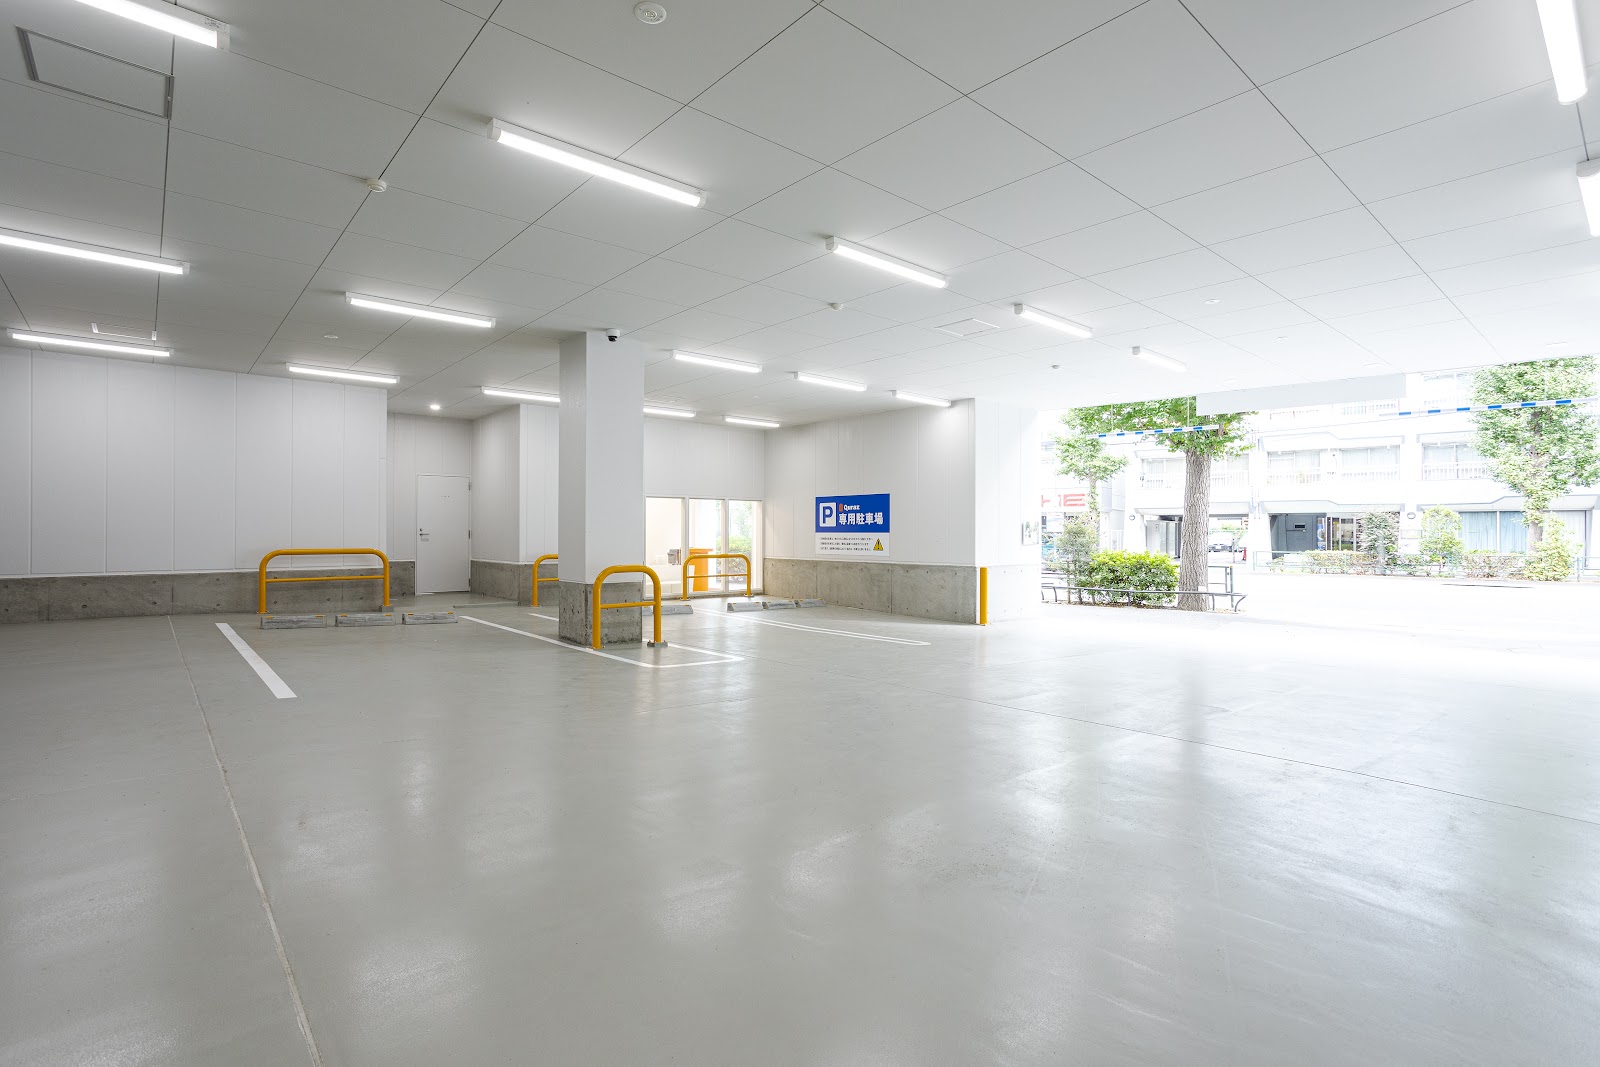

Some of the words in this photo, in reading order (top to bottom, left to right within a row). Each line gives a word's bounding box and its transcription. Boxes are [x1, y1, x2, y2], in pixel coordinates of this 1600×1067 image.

[822, 506, 834, 524] P
[839, 512, 884, 525] 専用駐車場
